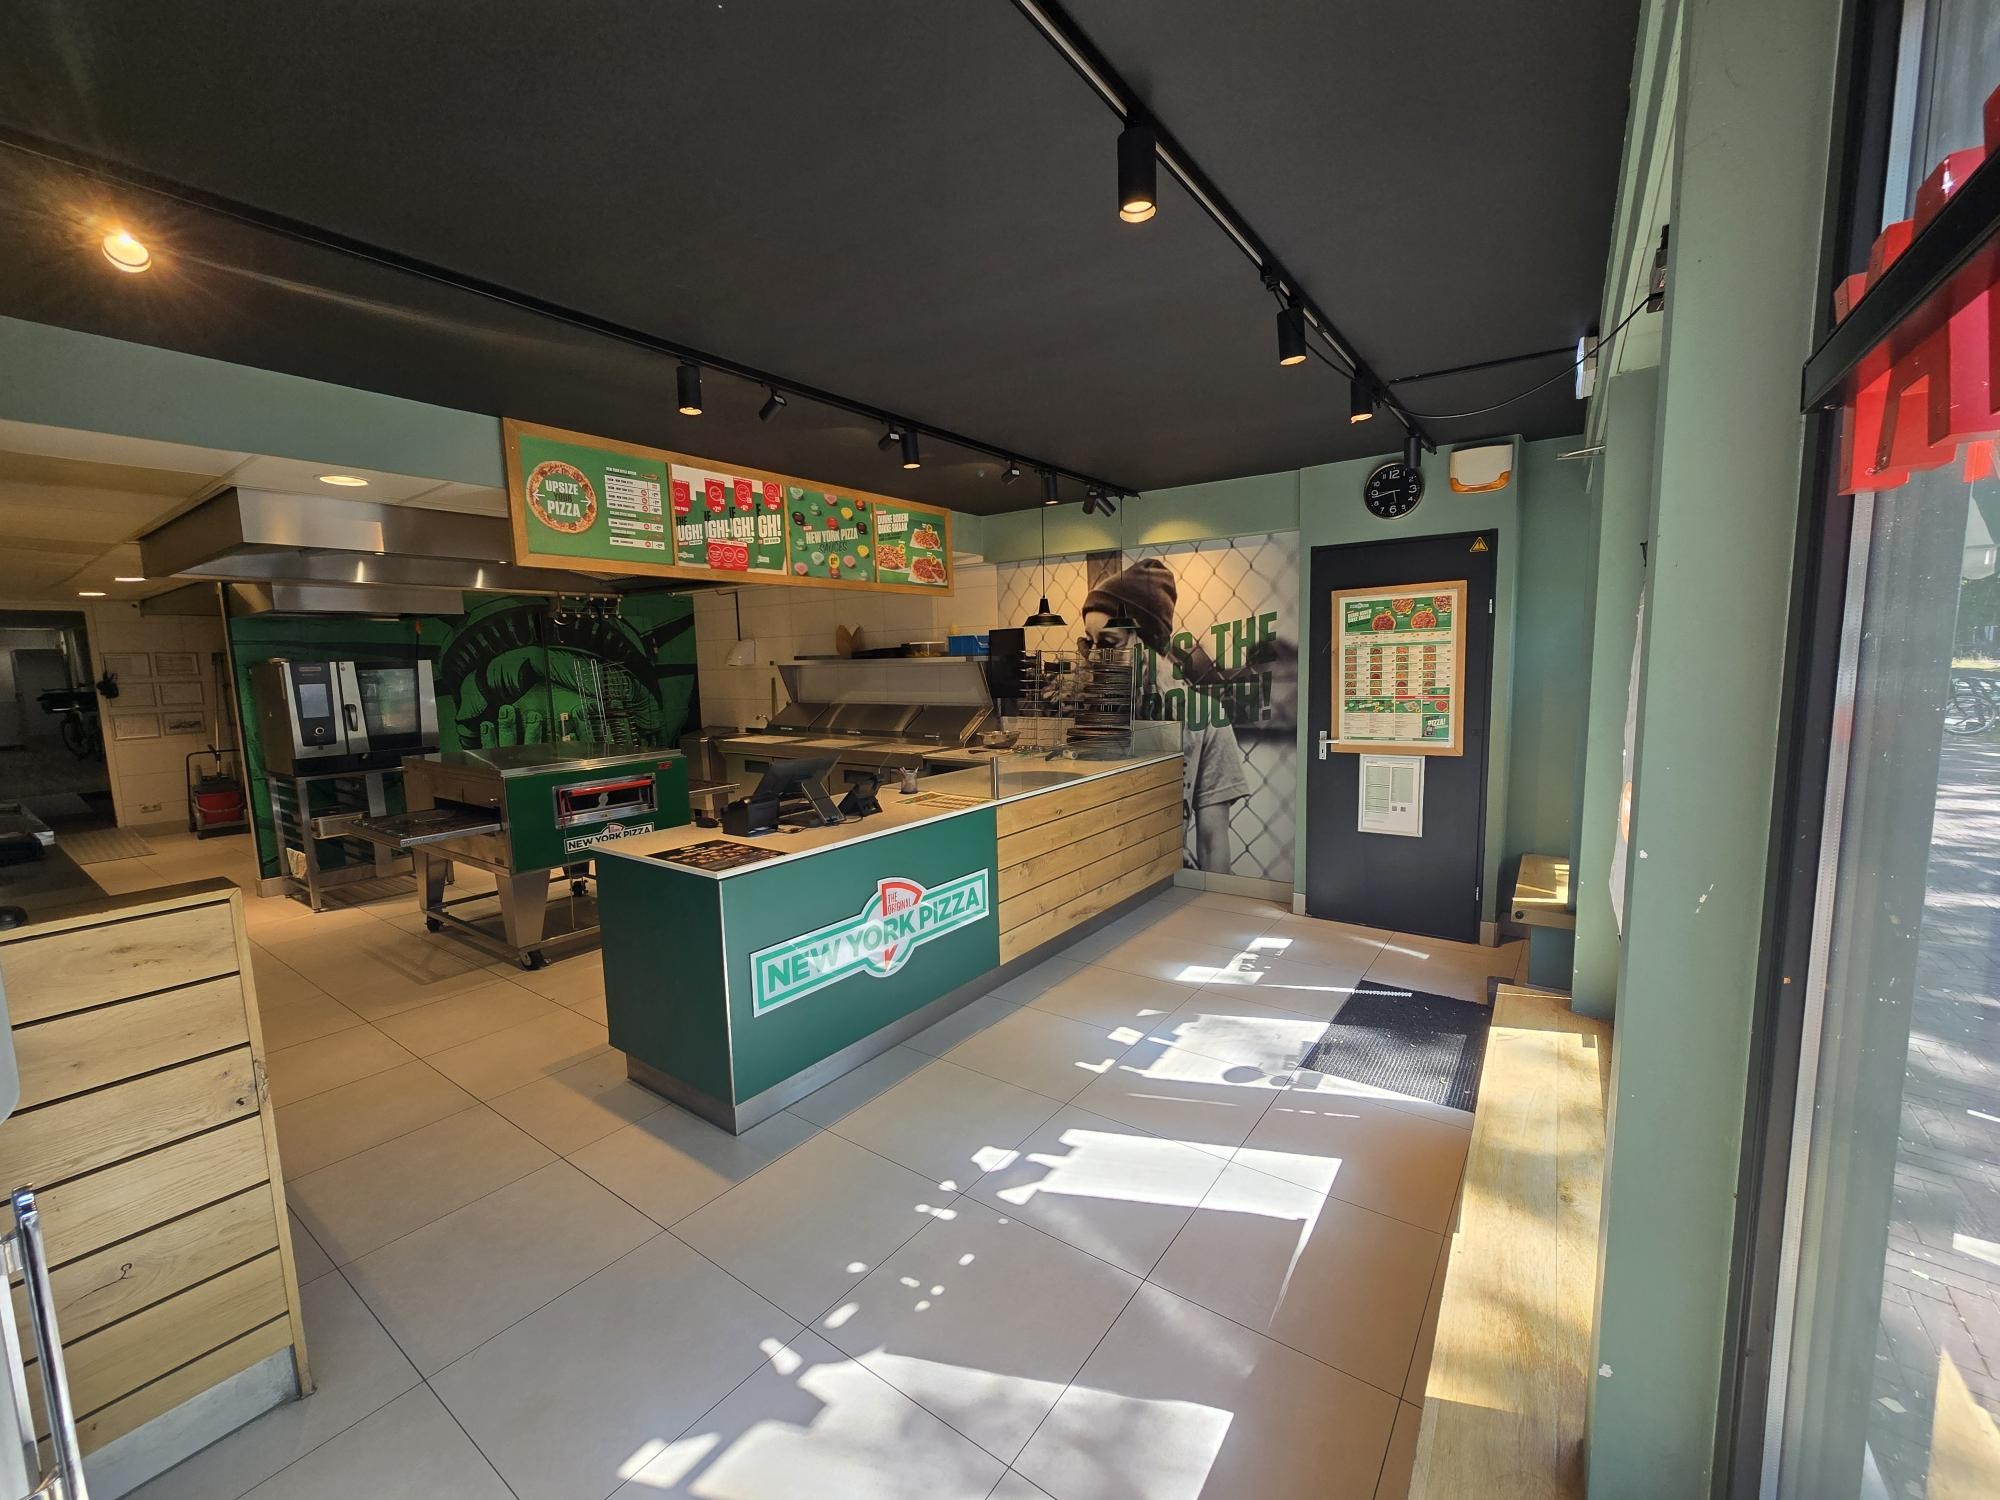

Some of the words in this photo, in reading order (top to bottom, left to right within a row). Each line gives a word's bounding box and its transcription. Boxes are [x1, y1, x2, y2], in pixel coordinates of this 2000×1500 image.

[1389, 470, 1400, 479] 12
[545, 480, 579, 495] UPSIZE
[1409, 485, 1417, 493] 3
[554, 492, 573, 503] YOUR
[547, 500, 581, 517] PIZZA
[1390, 505, 1397, 513] 6
[805, 530, 821, 544] NEW
[821, 528, 840, 542] YORK
[841, 527, 858, 540] PIZZA
[1134, 631, 1194, 688] ITS
[1211, 612, 1277, 673] THE
[568, 837, 593, 849] NEW
[595, 832, 622, 843] YORK
[623, 826, 651, 838] PIZZA
[887, 891, 898, 904] THE
[887, 898, 912, 915] ORIGINAL
[768, 938, 842, 993] NEW
[846, 910, 916, 958] YORK
[920, 887, 980, 930] PIZZA
